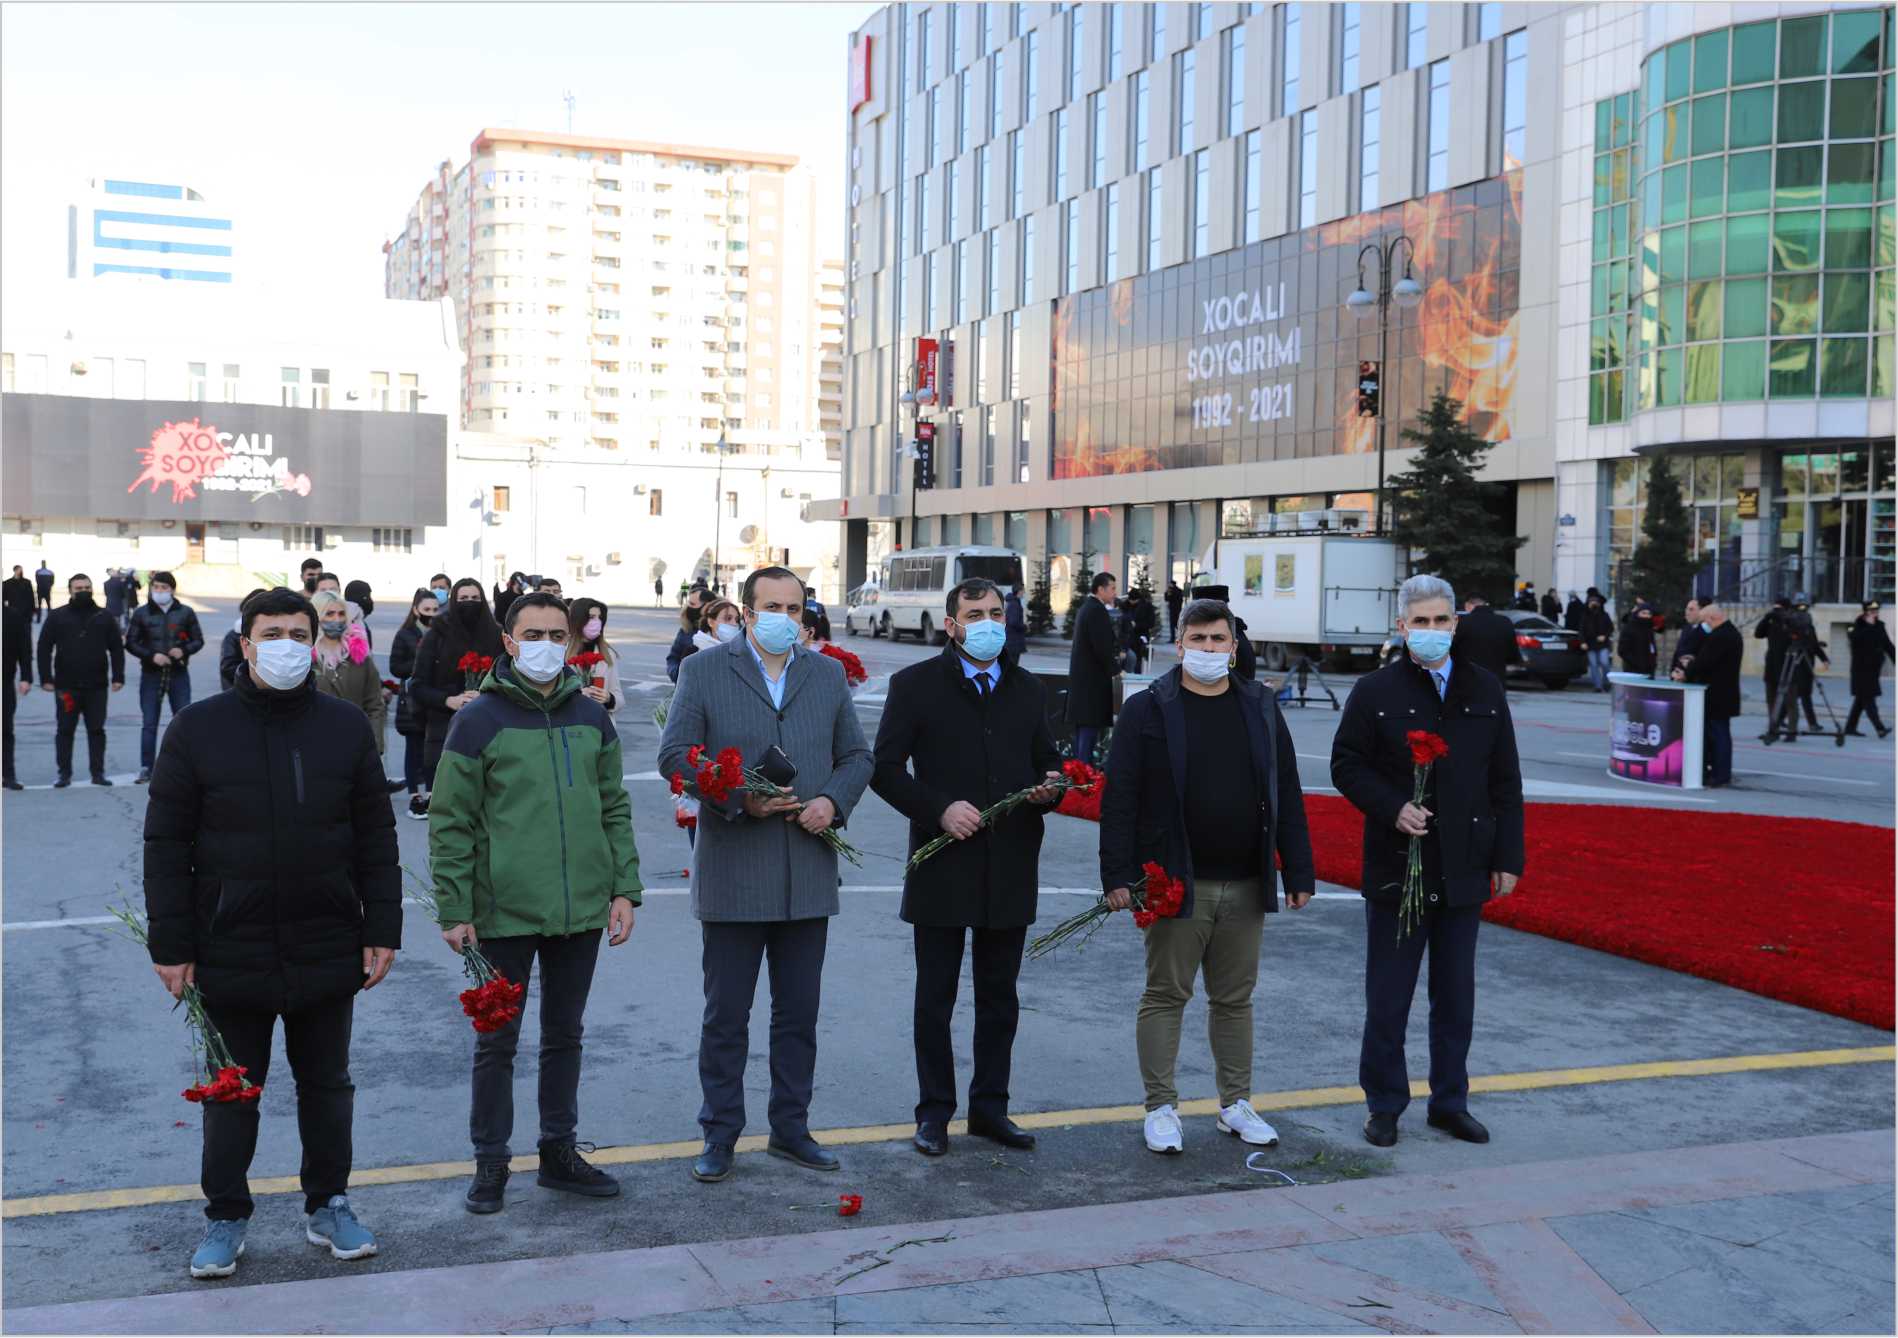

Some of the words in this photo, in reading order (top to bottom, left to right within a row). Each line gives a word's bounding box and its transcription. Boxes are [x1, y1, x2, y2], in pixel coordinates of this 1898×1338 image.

[1202, 282, 1285, 334] XOCALI
[1188, 327, 1302, 382] SOYQIRIMI
[1193, 393, 1233, 429] 1992
[1250, 384, 1293, 422] 2021
[178, 432, 273, 456] XOCALI
